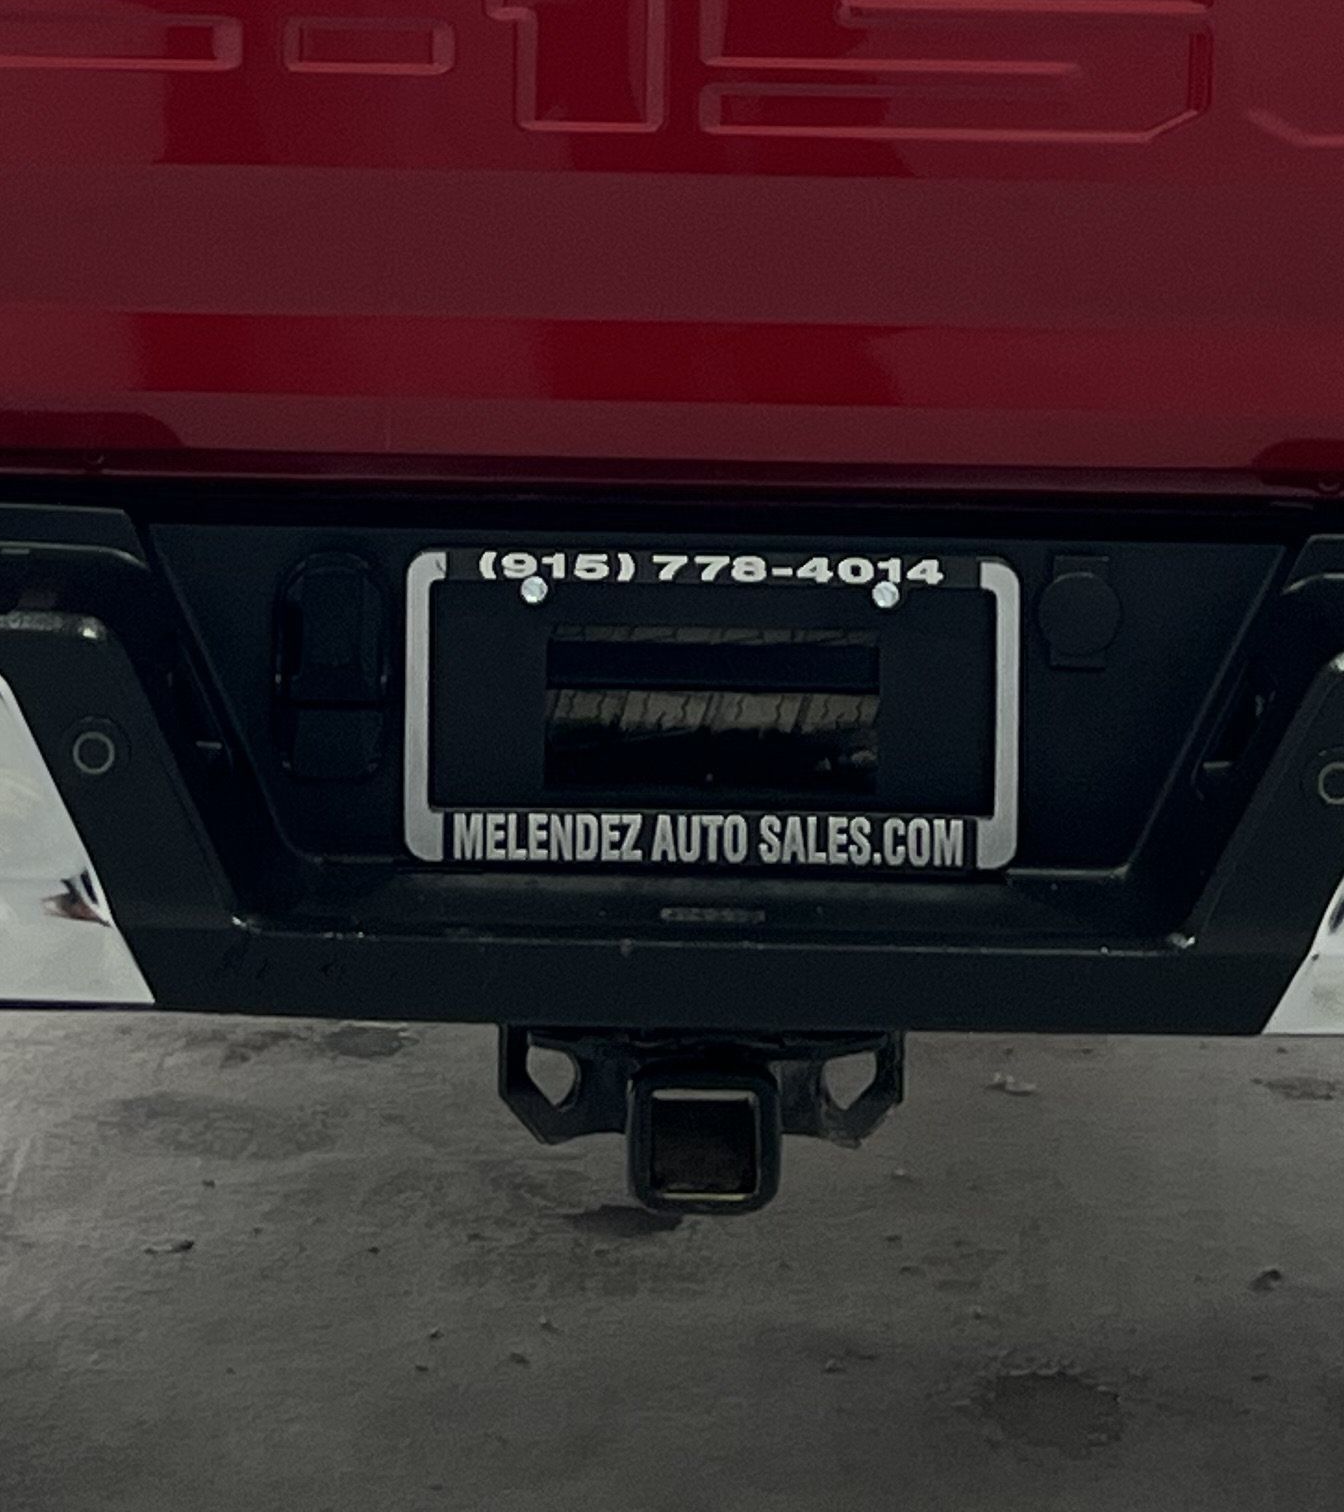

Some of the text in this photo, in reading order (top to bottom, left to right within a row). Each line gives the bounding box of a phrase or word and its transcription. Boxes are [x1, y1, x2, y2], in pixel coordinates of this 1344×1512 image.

[479, 551, 944, 585] (915) 778-4014
[453, 812, 965, 867] MELENDEZ AUTO SALES.COM
